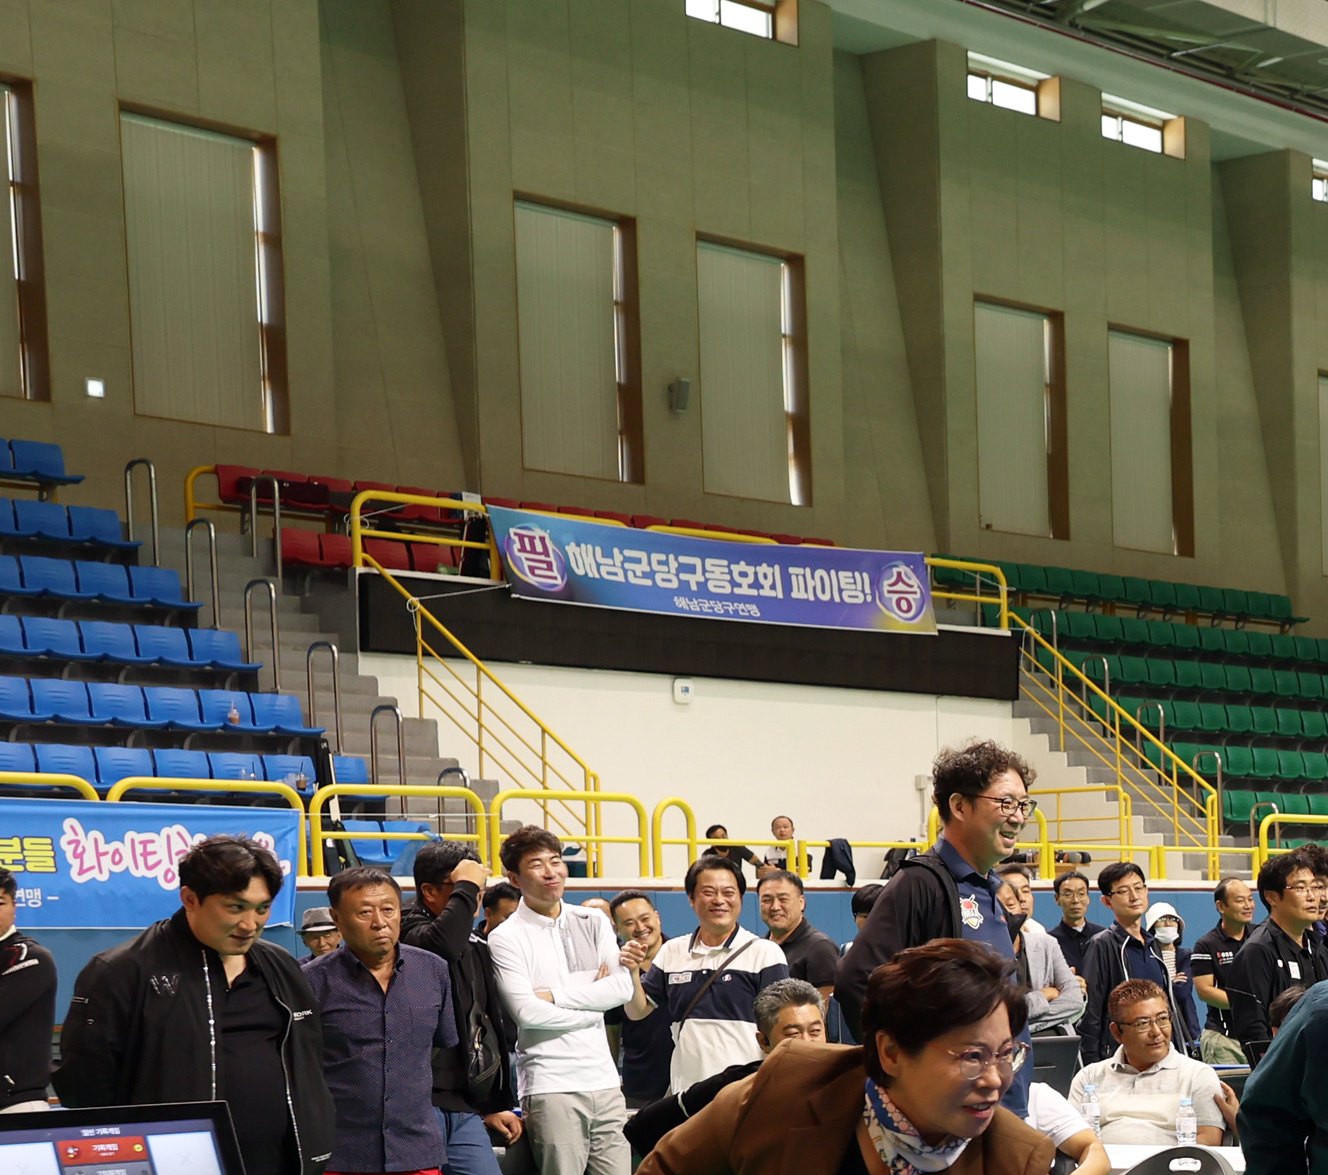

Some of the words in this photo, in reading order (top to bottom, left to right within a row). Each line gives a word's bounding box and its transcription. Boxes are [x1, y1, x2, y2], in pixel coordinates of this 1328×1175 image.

[511, 528, 562, 587] 필
[565, 541, 783, 600] 해남군당구동호회
[789, 565, 873, 605] 파이팅!
[884, 566, 921, 618] 승
[673, 595, 761, 618] 해남군당구연맹
